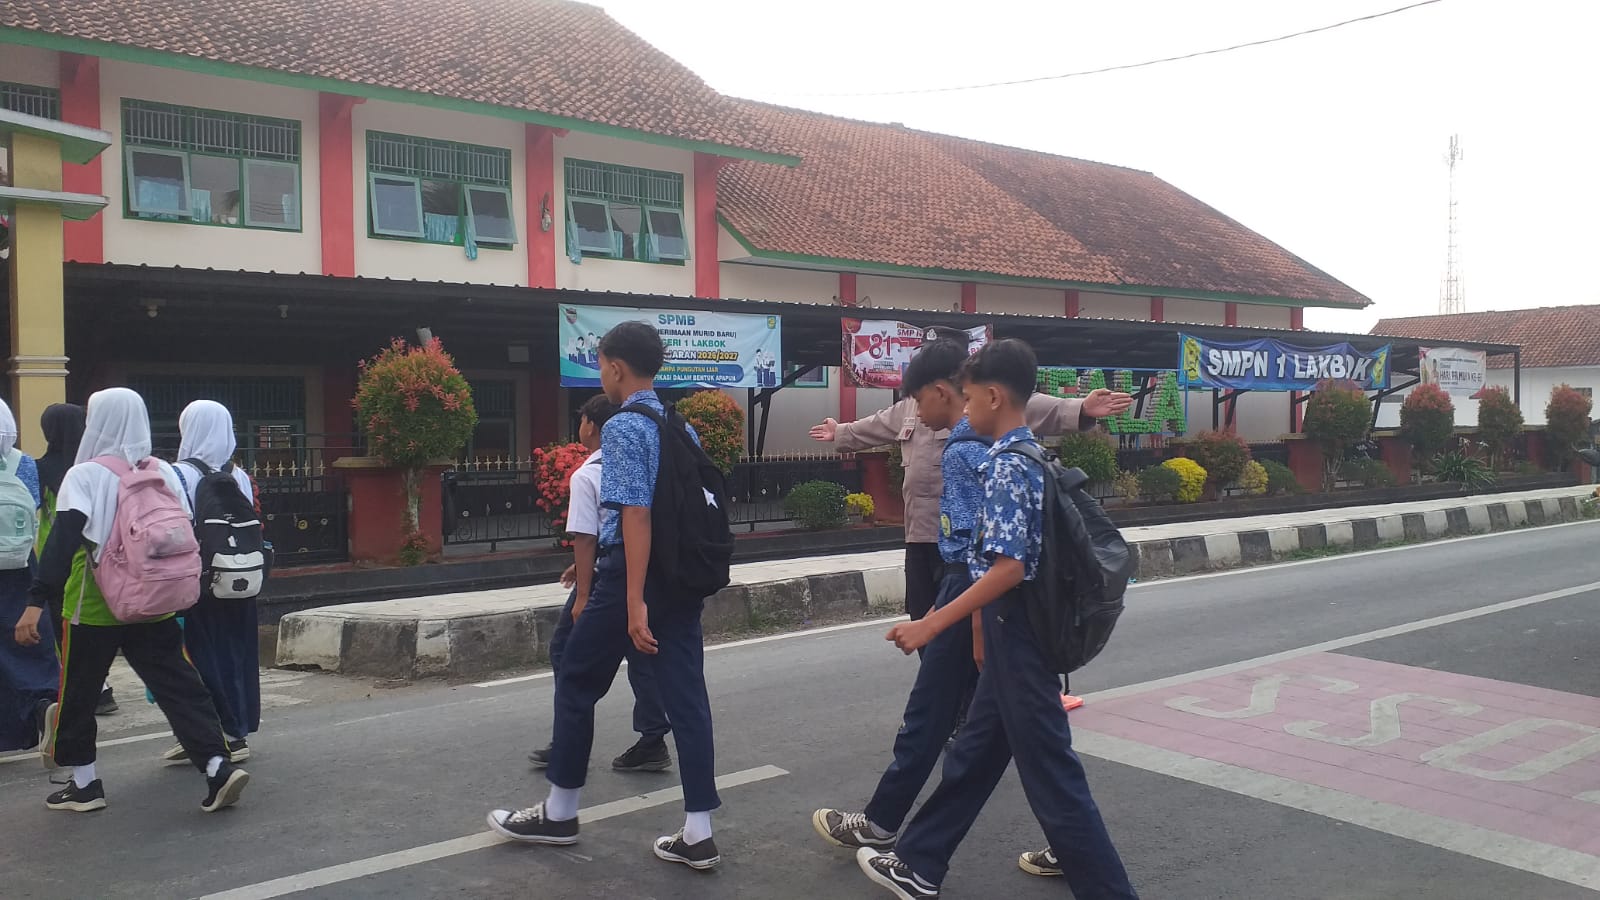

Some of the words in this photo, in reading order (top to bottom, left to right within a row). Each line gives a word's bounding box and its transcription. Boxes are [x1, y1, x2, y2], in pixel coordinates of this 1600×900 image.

[658, 313, 696, 326] SPMB
[897, 328, 915, 337] SMP
[662, 338, 681, 347] GERI
[684, 339, 688, 347] 1
[691, 339, 726, 348] LAKBOK
[869, 333, 891, 360] 81
[663, 350, 697, 360] JARAN
[697, 349, 739, 362] 2026/2027
[1207, 348, 1269, 377] SMPN
[1276, 353, 1286, 378] 1
